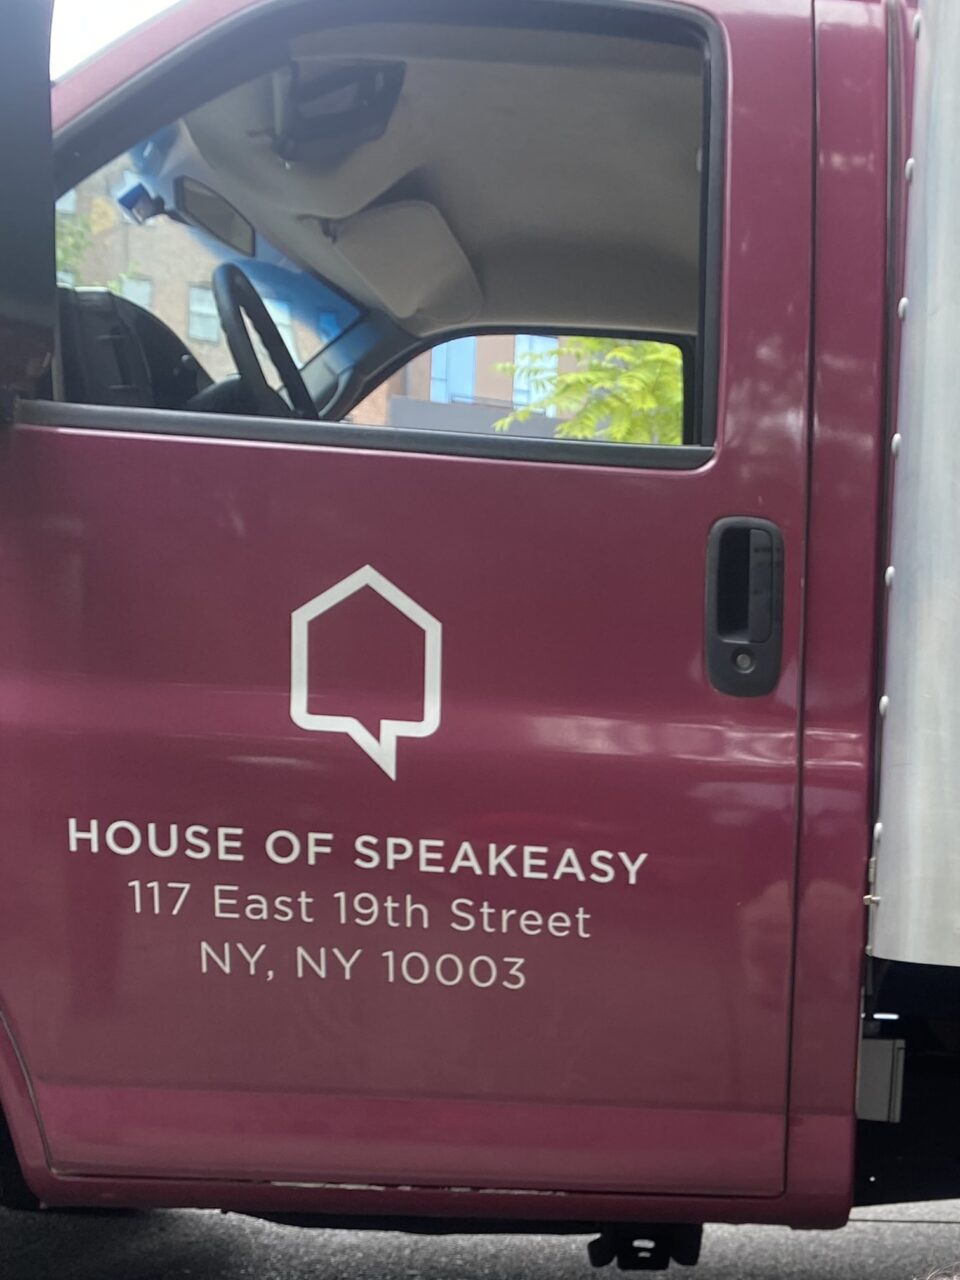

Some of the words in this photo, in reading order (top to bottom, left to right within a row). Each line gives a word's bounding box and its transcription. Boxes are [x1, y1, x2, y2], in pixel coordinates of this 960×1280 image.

[67, 816, 245, 865] HOUSE
[264, 829, 335, 867] OF
[353, 834, 649, 886] SPEAKEASY
[127, 879, 192, 917] 117
[213, 883, 315, 925] East
[332, 890, 430, 930] 19th
[449, 897, 592, 939] Street
[199, 940, 275, 981] NY,
[295, 945, 363, 982] NY
[380, 950, 527, 990] 10003
